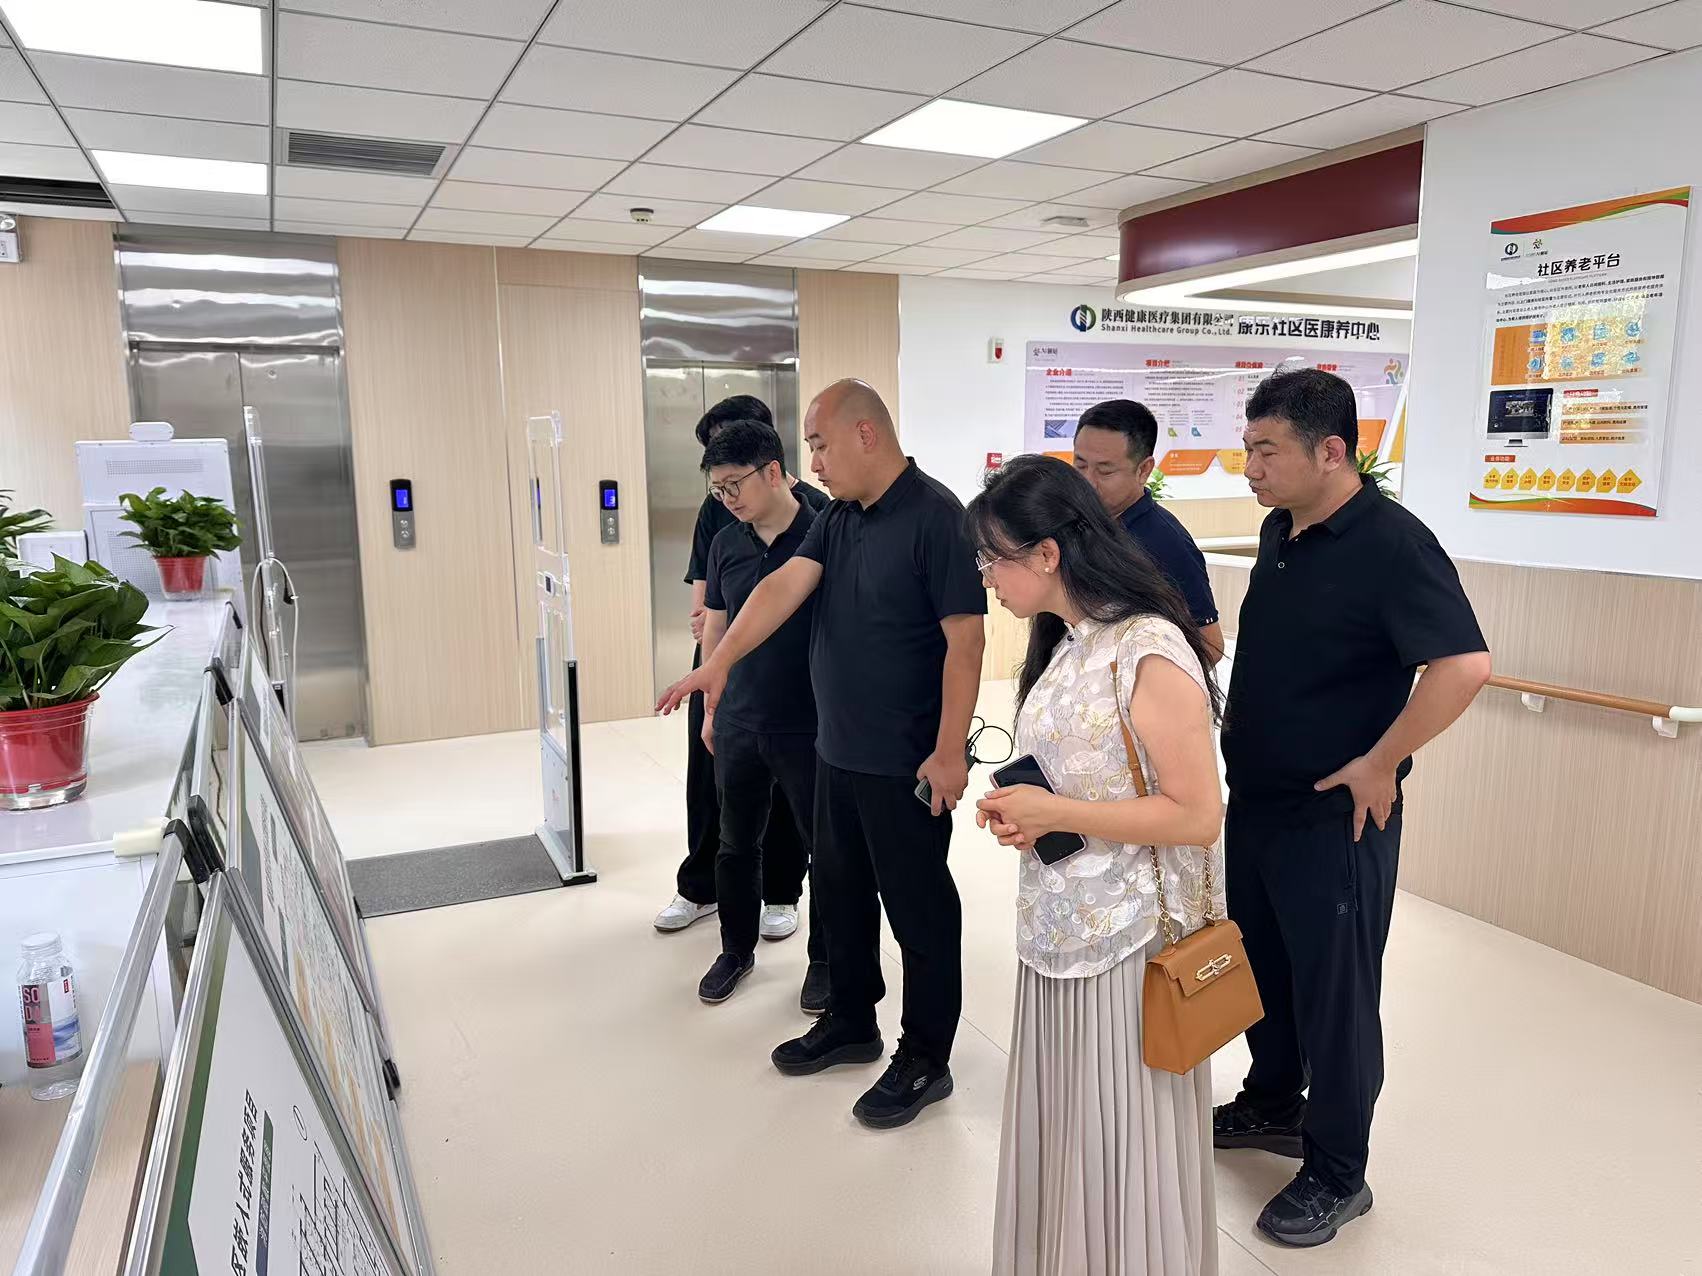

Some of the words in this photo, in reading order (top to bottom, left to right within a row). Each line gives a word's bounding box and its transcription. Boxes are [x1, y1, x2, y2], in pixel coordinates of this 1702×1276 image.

[1537, 253, 1621, 277] 社区养老平台
[1100, 308, 1234, 327] 陕西健康医疗集团有限公司
[1101, 323, 1128, 332] Shanxi
[1131, 324, 1174, 334] Healthcare
[1176, 326, 1200, 336] Group
[22, 987, 41, 1003] SO
